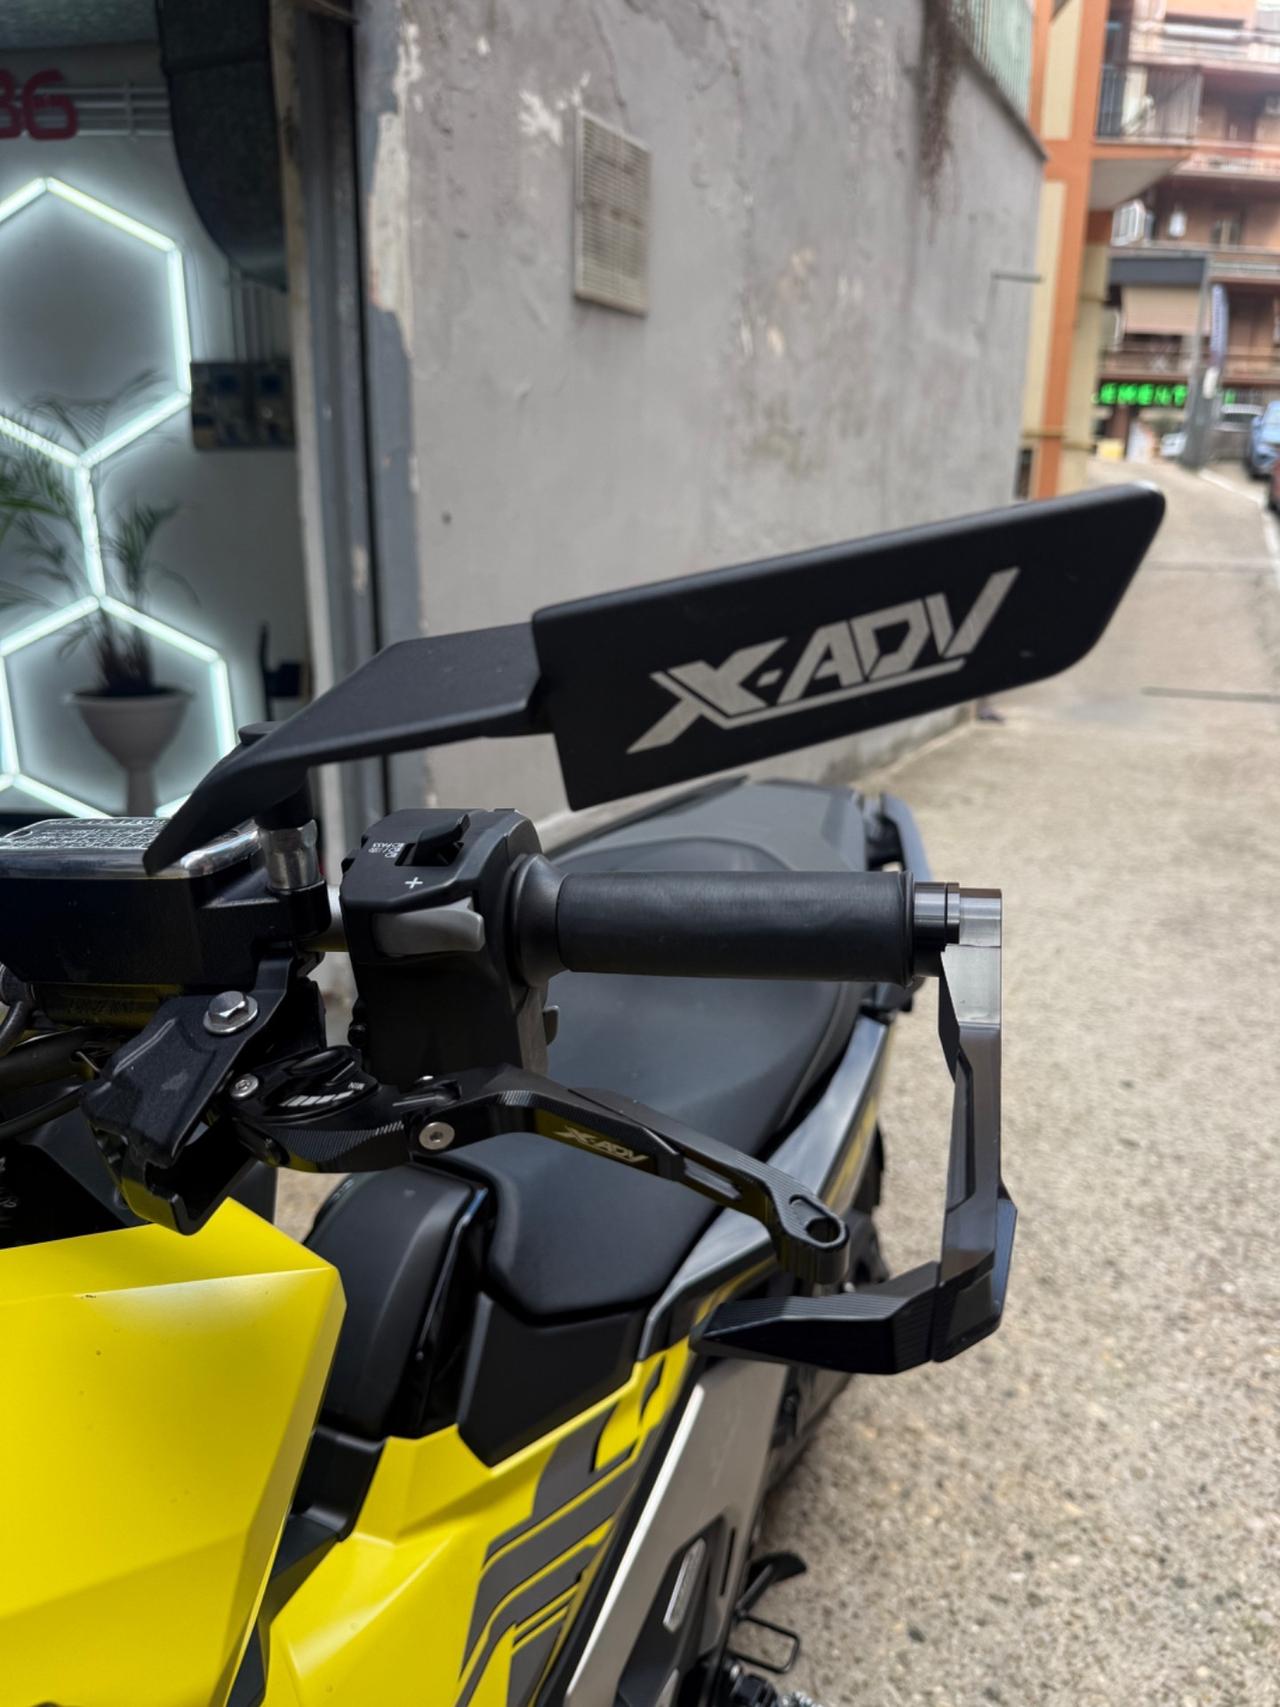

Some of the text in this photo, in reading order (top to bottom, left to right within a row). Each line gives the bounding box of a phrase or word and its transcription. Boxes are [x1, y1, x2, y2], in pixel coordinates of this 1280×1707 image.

[1092, 382, 1188, 407] EMENT
[626, 566, 1020, 754] X-ADV
[552, 1126, 649, 1162] X-ADV
